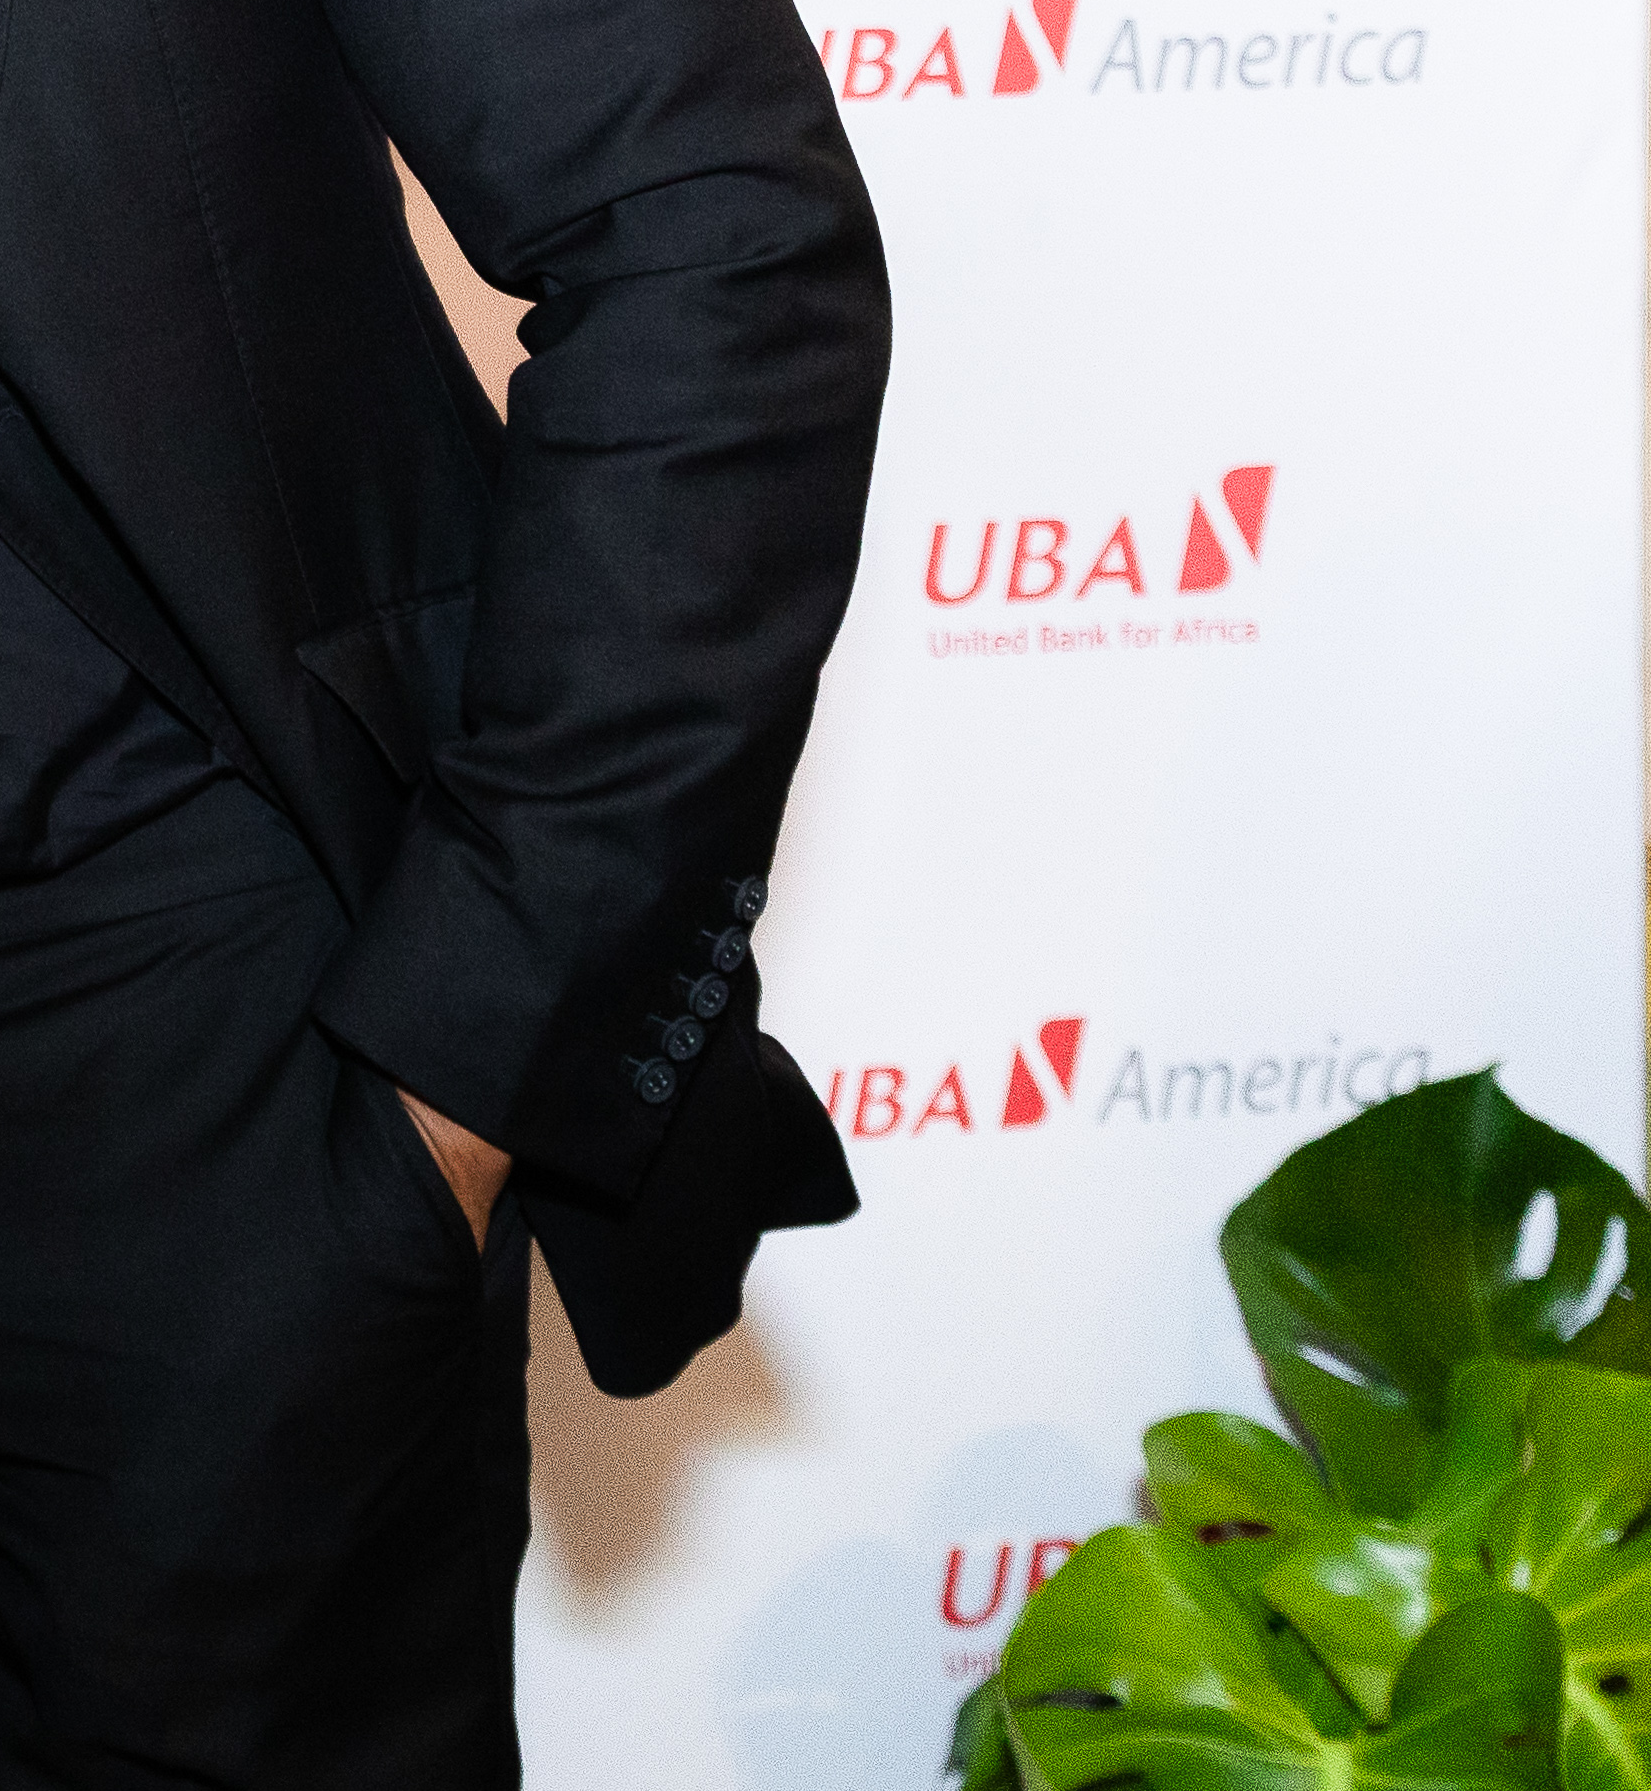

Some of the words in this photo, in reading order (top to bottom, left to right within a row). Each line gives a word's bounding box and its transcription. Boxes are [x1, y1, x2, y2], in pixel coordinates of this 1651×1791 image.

[821, 26, 965, 101] BA
[1088, 11, 1429, 96] America
[922, 516, 1146, 607] UBA
[928, 626, 1029, 659] United
[1038, 622, 1111, 654] Bank
[1120, 619, 1160, 649] for
[1172, 616, 1260, 646] Africa
